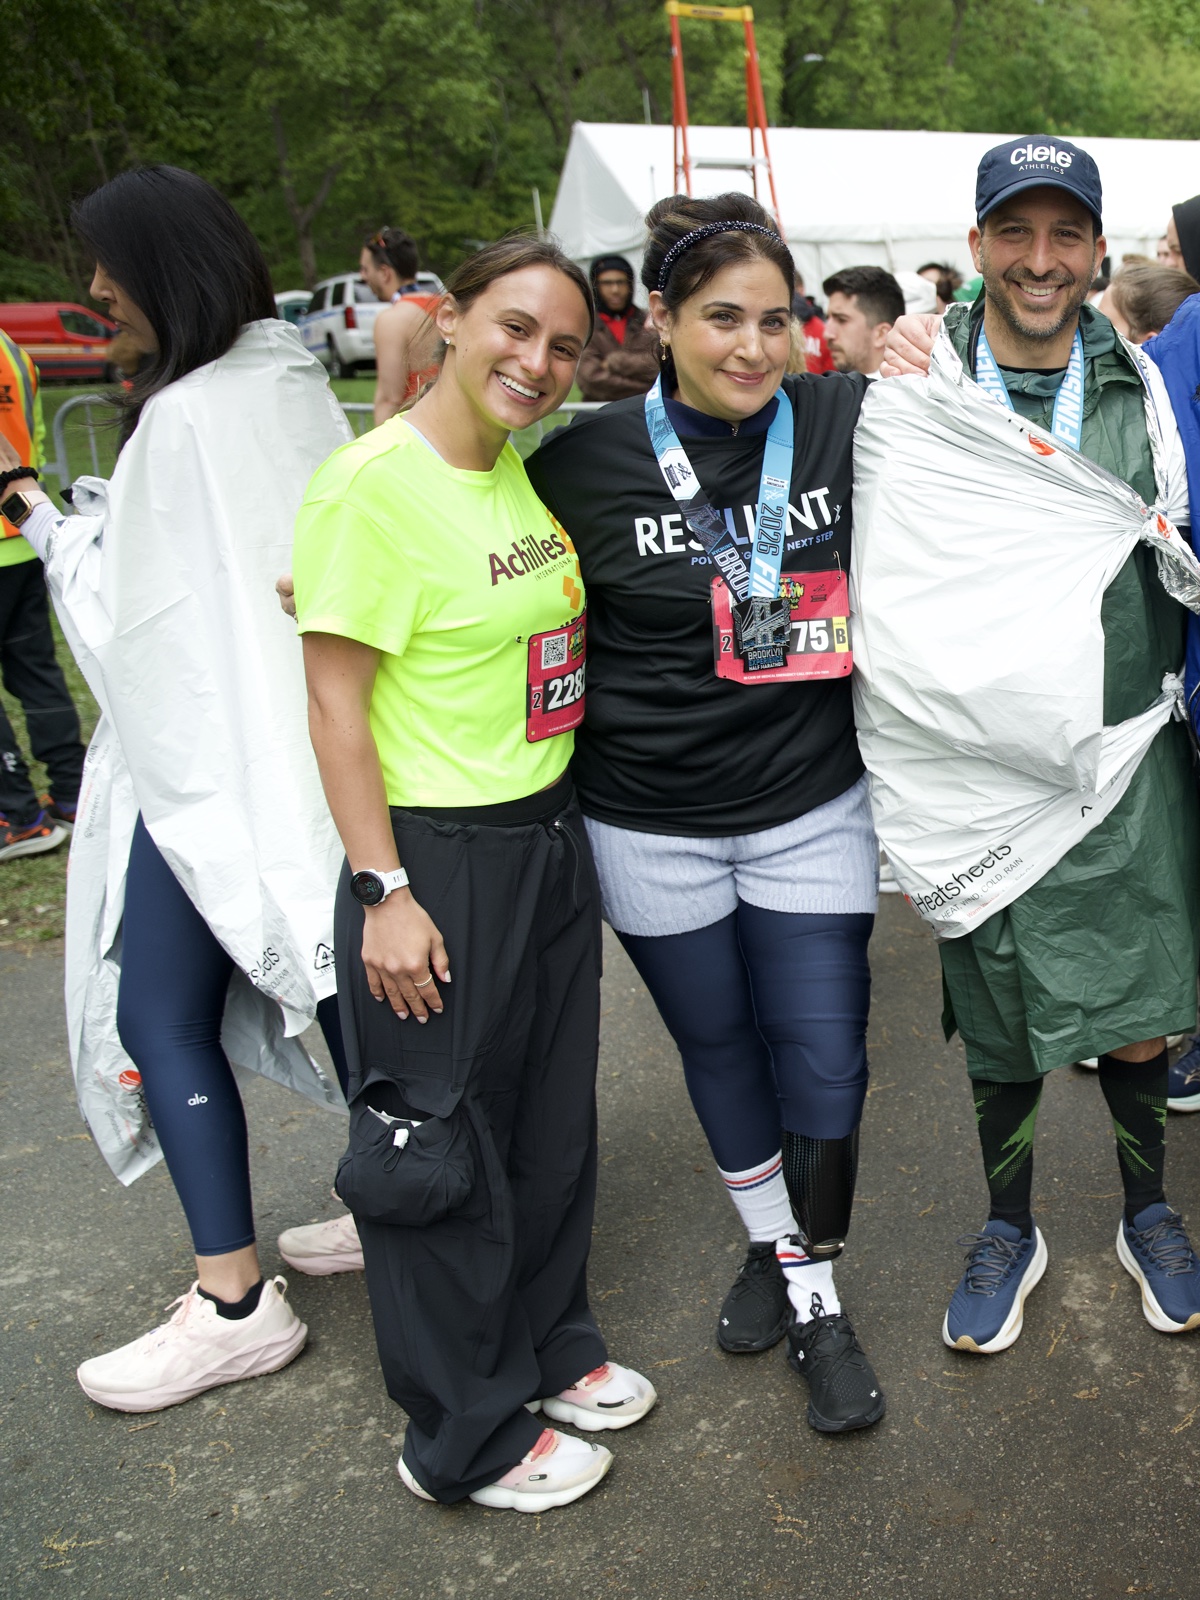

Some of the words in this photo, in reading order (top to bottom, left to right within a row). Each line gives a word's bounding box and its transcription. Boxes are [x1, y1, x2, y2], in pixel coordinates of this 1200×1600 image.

[1018, 163, 1065, 175] ATHLETICS
[757, 502, 785, 557] 2026
[786, 536, 814, 551] NEXT
[814, 530, 835, 545] STEP
[488, 532, 567, 587] Achilles
[534, 556, 573, 581] INTERNATIONAL
[721, 635, 732, 653] 2
[835, 628, 847, 645] B
[747, 647, 784, 660] BROOKLYN
[760, 662, 784, 670] MARATHON
[531, 692, 542, 709] 2
[910, 844, 1012, 915] Heatsheets
[941, 902, 963, 920] HEAT,
[982, 873, 1006, 894] COLD,
[1003, 856, 1024, 874] RAIN
[187, 1092, 209, 1107] alo
